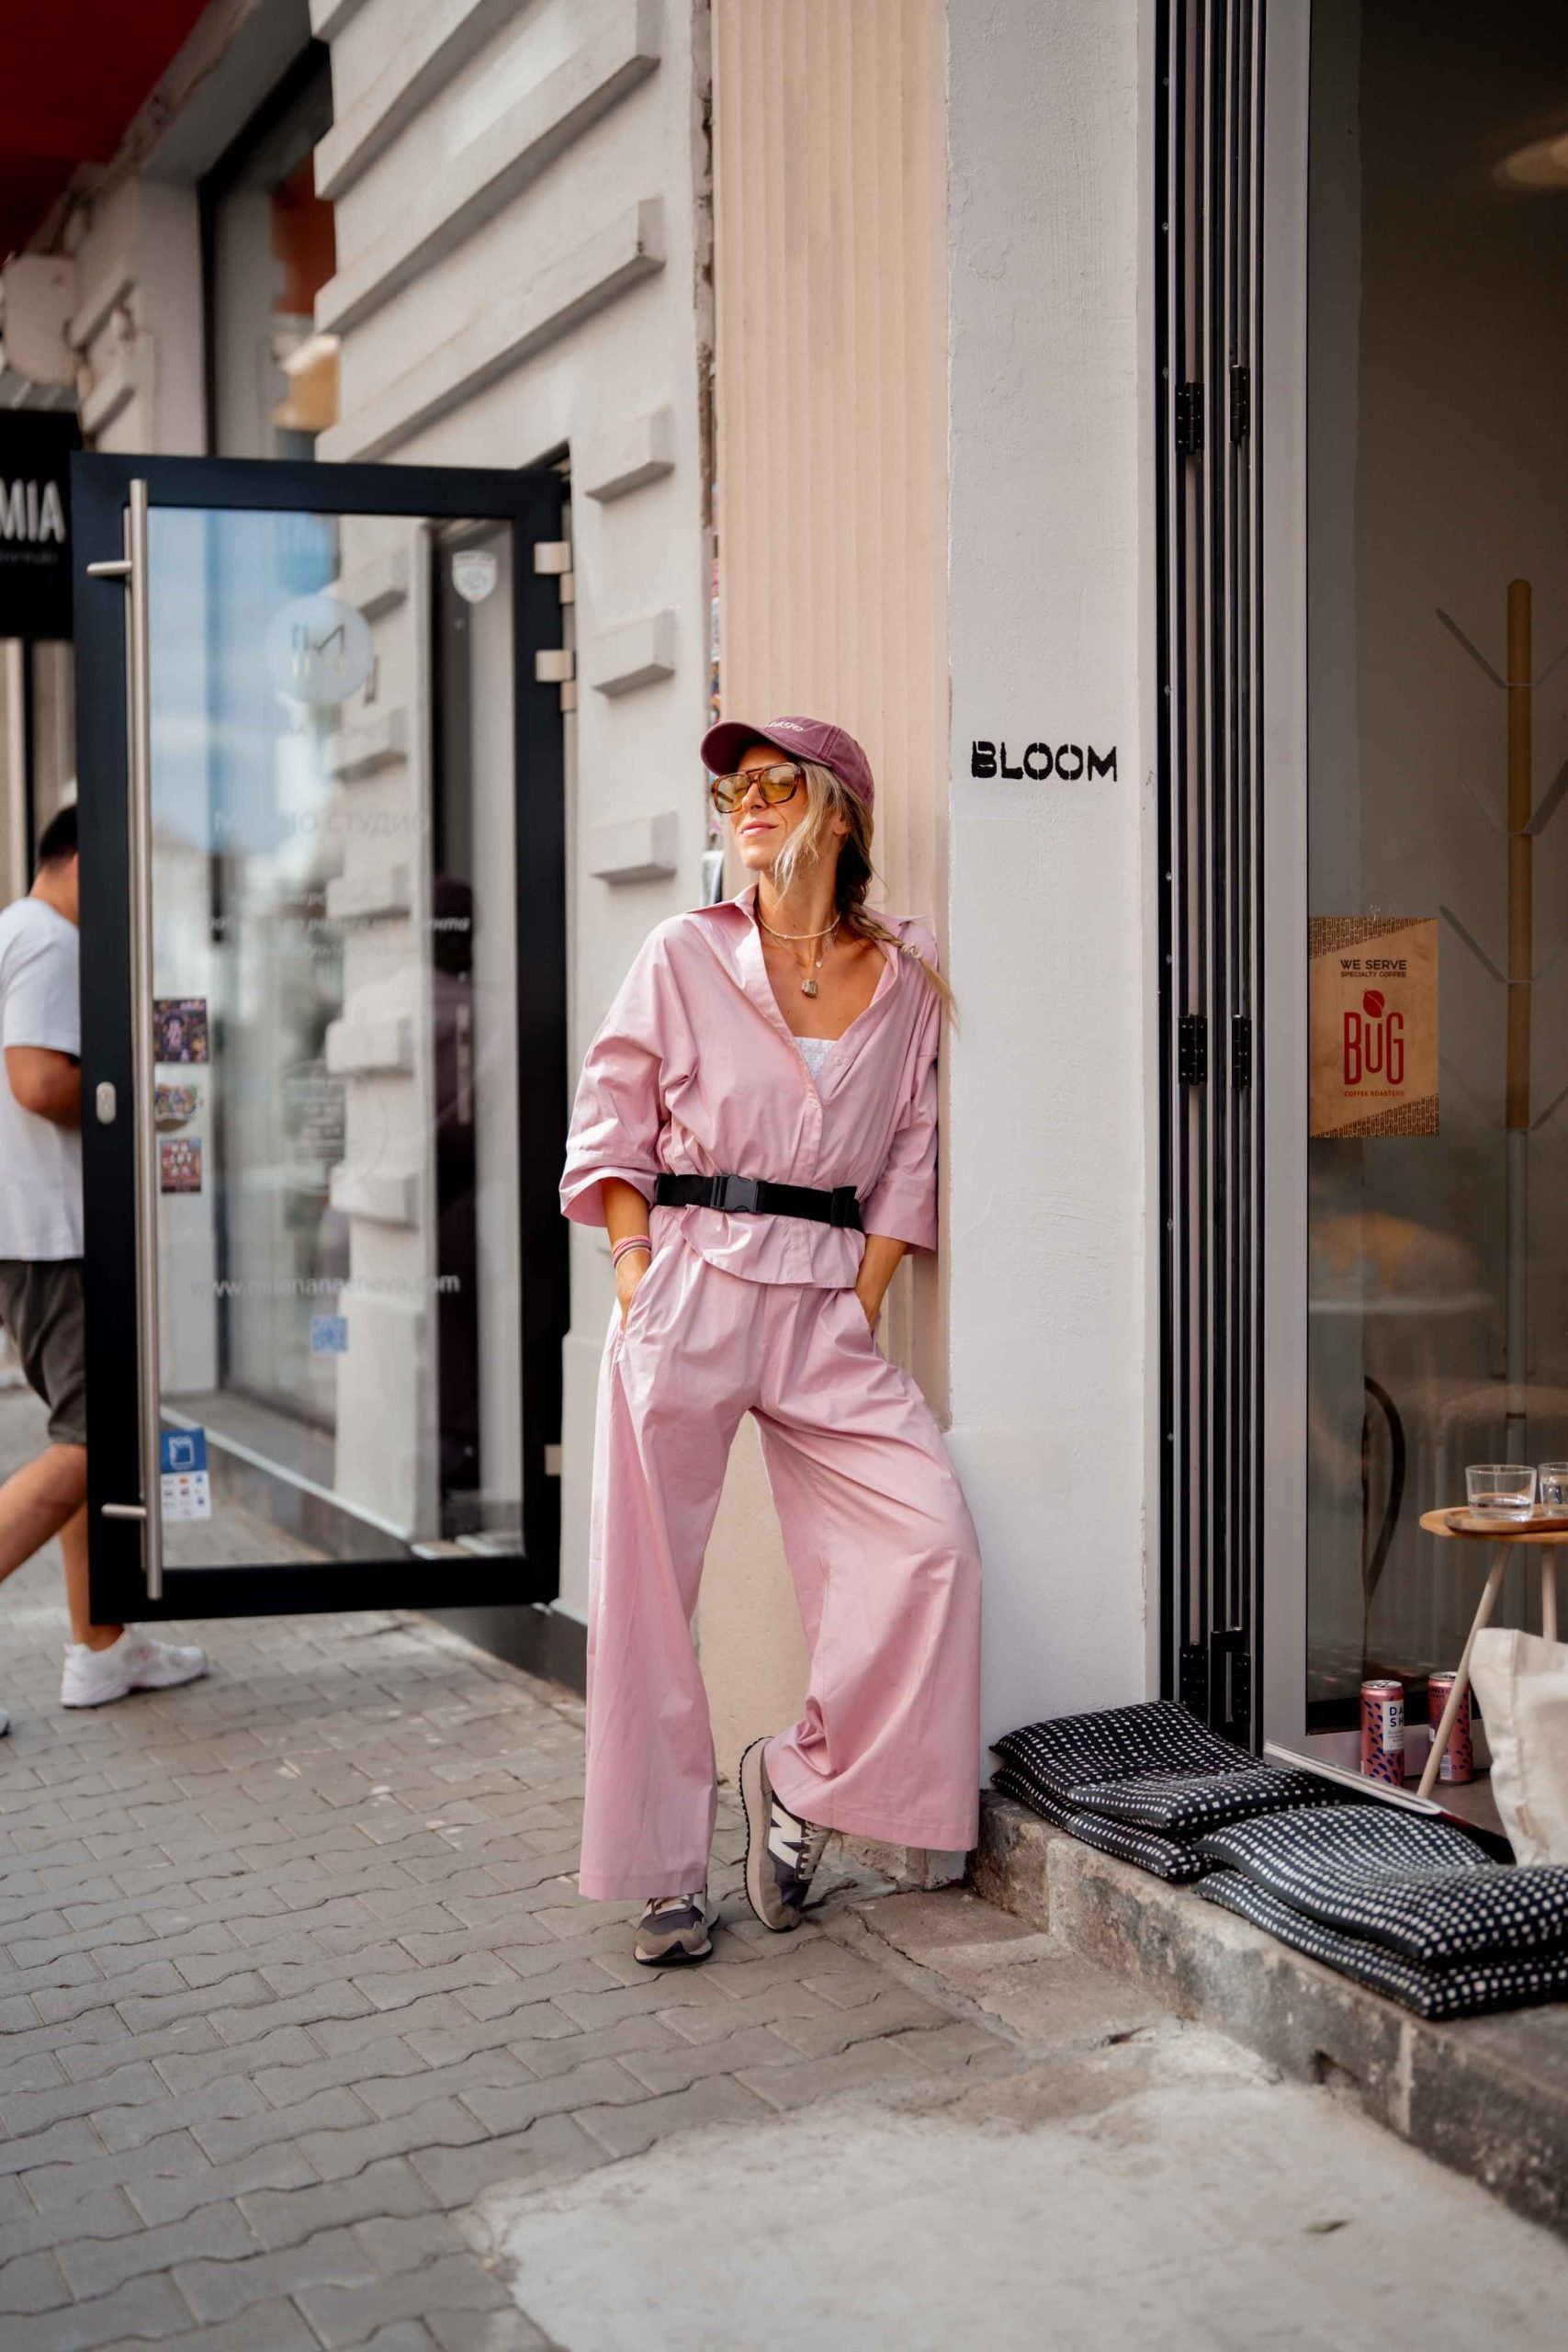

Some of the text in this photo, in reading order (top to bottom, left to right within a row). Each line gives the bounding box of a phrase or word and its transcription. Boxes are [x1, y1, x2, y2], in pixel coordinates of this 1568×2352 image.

[971, 741, 1117, 782] BLOOM
[1340, 959, 1407, 970] WE SERVE
[1344, 1012, 1404, 1085] BUG
